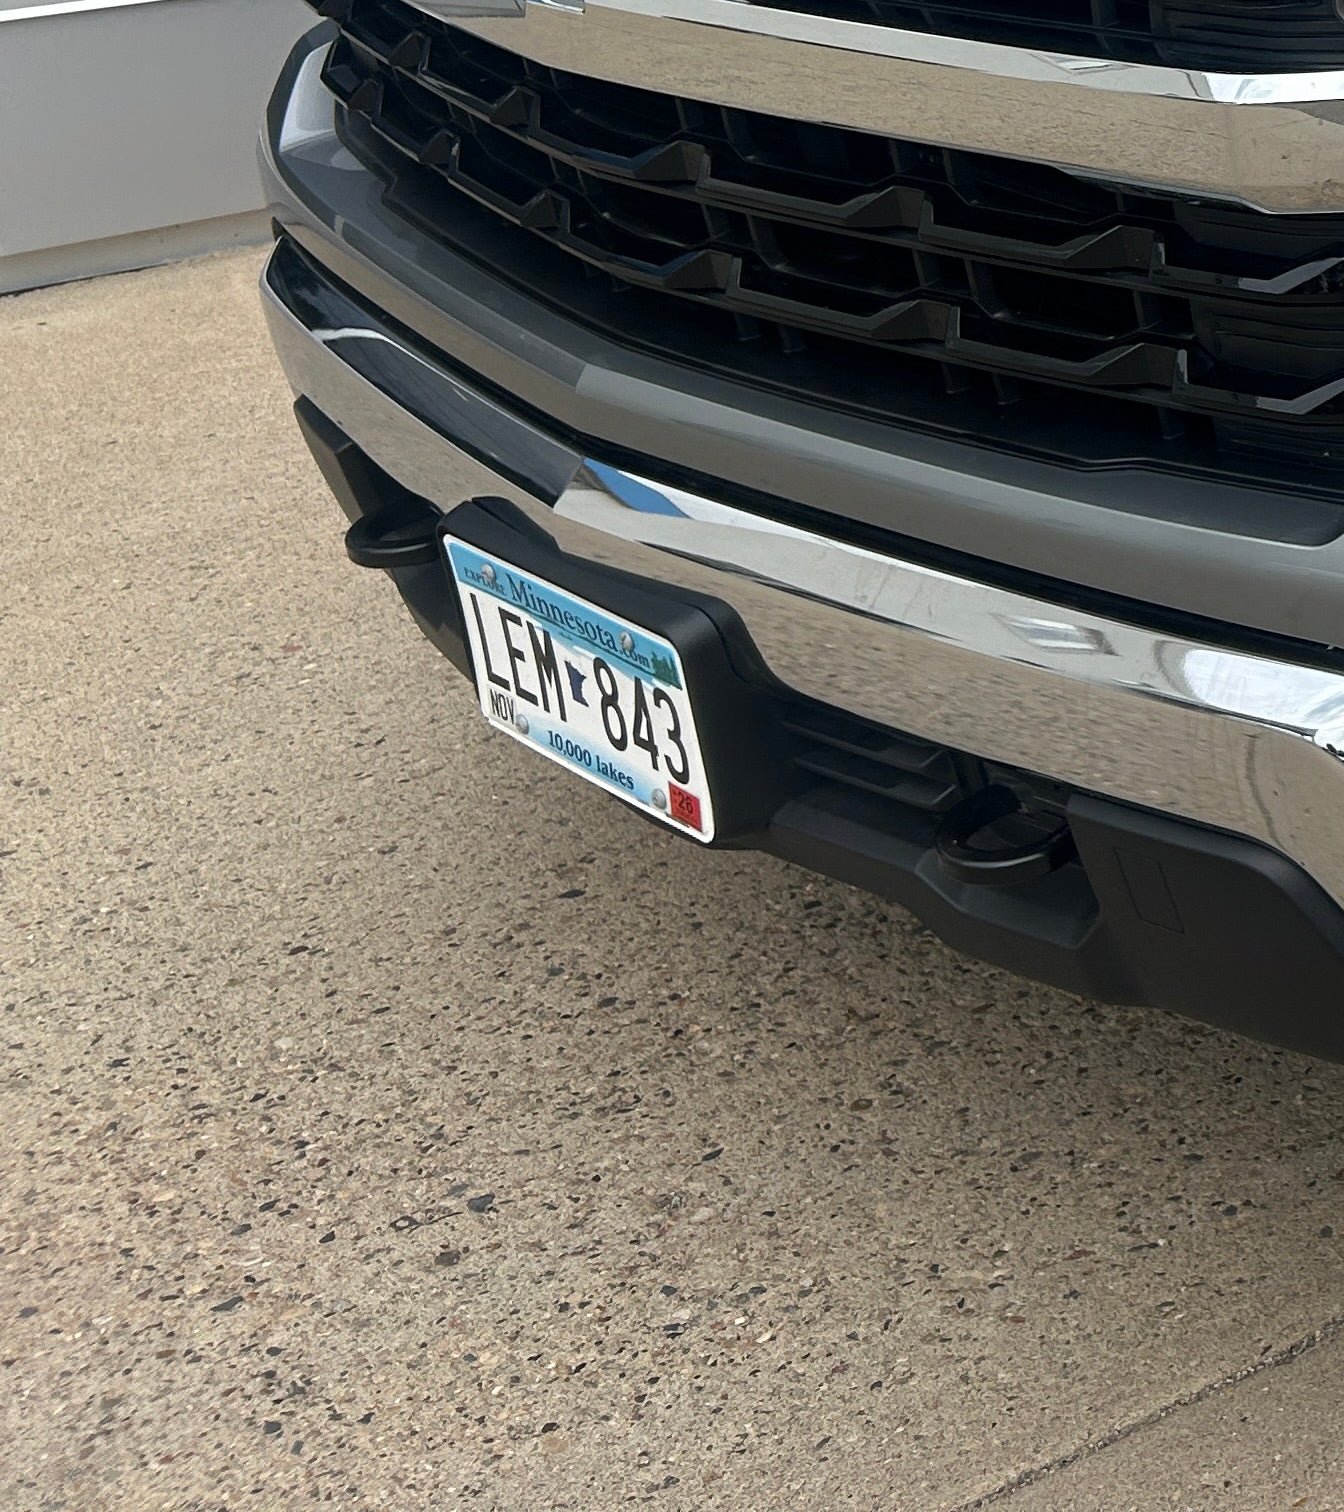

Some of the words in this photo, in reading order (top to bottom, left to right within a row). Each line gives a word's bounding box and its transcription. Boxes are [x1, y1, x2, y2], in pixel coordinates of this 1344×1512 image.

[470, 592, 568, 723] LEM
[593, 657, 690, 785] 843
[490, 689, 515, 725] NOV
[548, 730, 592, 767] 10,000
[596, 755, 635, 791] lakes
[677, 791, 693, 815] 26
